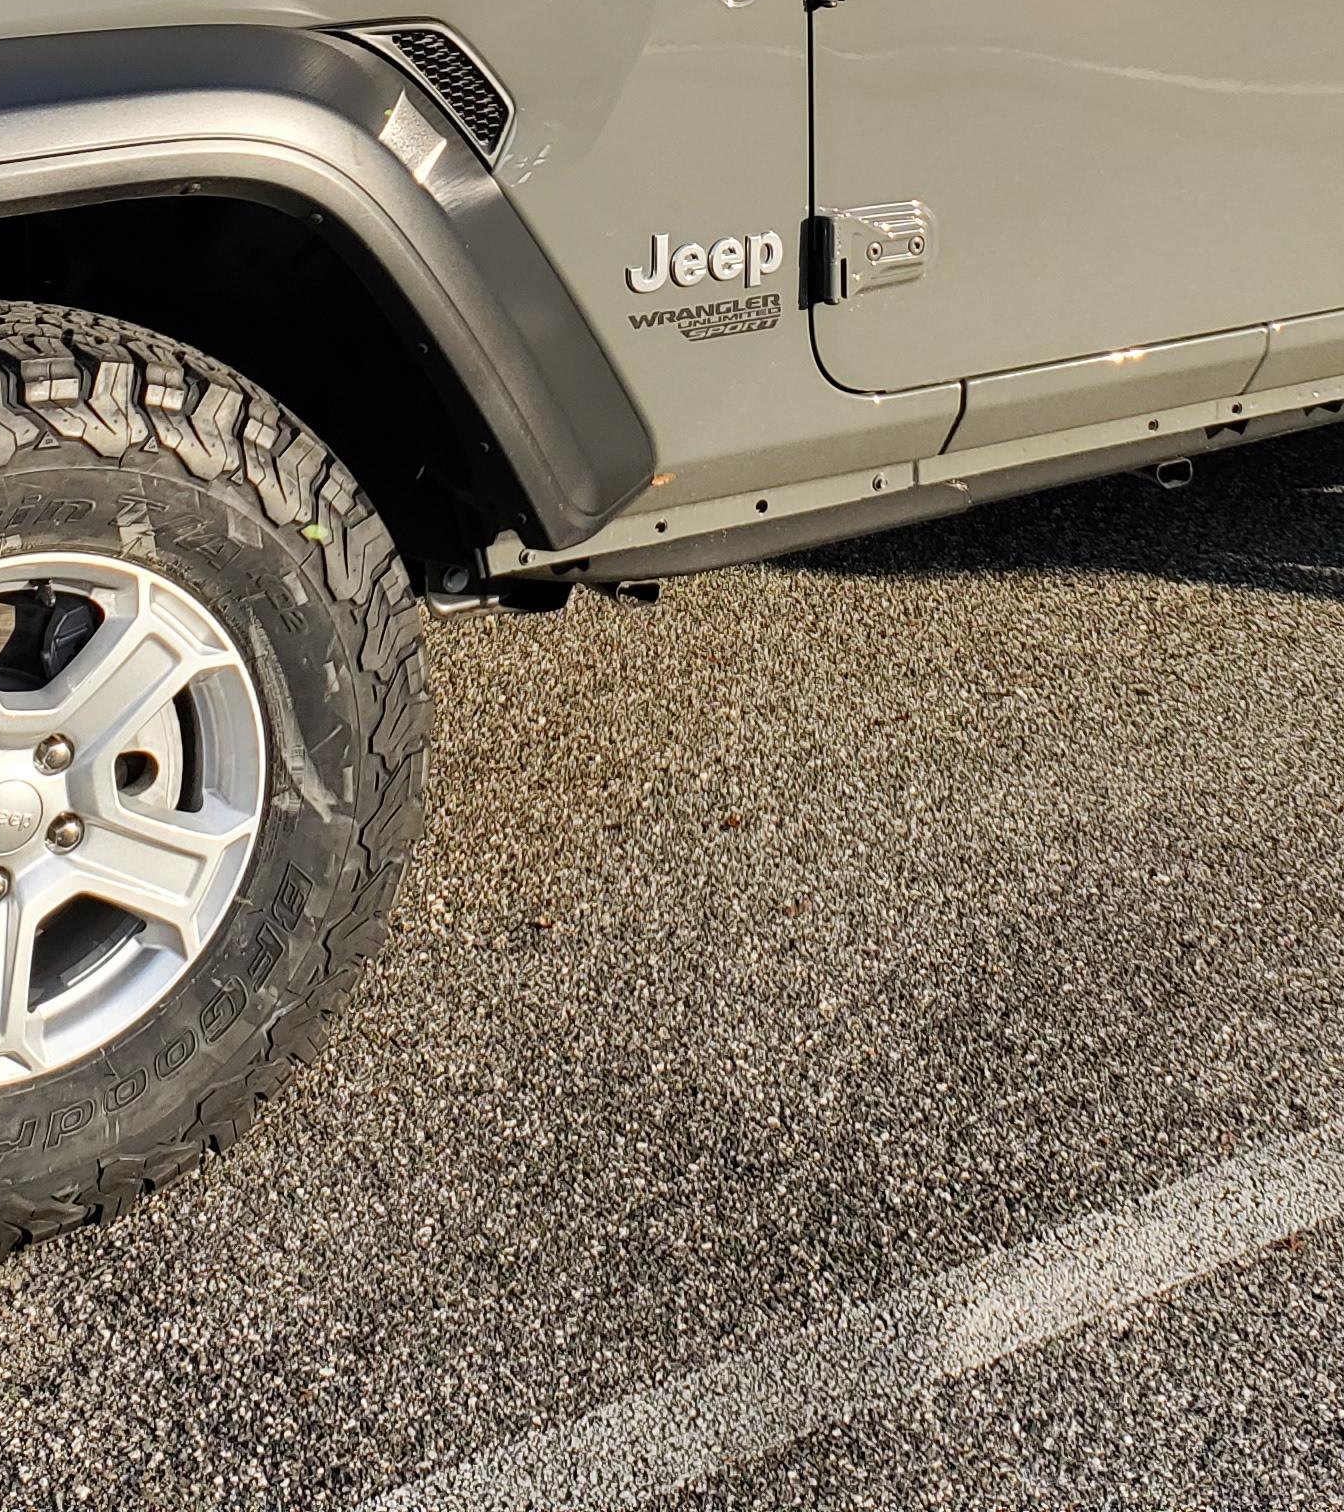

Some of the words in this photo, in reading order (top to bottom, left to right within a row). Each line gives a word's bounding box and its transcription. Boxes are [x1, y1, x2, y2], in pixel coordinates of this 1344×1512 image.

[625, 231, 783, 293] Jeep
[628, 293, 781, 330] WRANGLER
[677, 306, 781, 329] UNLIMITED
[679, 318, 779, 342] SPORT
